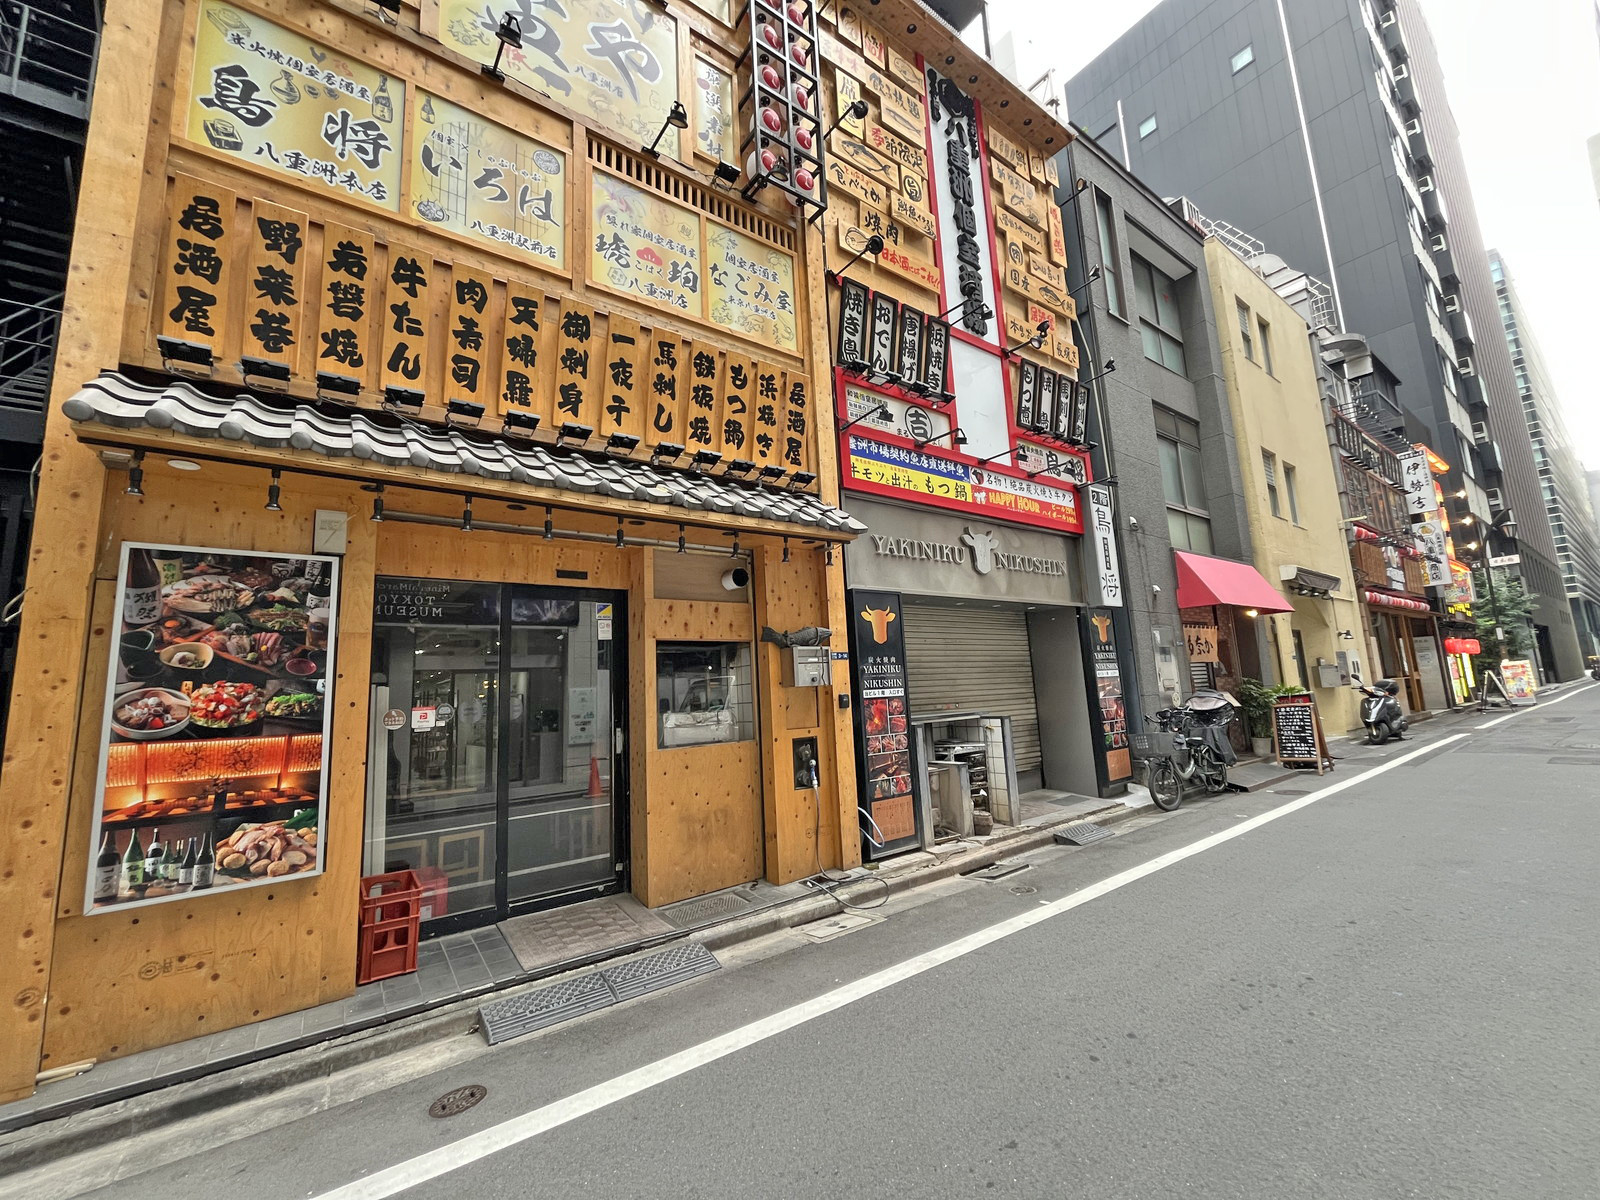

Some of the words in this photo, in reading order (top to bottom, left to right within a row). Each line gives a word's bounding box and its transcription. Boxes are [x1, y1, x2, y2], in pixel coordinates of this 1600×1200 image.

[254, 142, 389, 201] 八重洲本店
[421, 144, 561, 228] いろは
[169, 196, 224, 337] 居酒屋
[470, 220, 557, 259] 八重洲駅前店
[725, 251, 781, 285] 個室居酒屋
[250, 217, 302, 353] 野菜巻
[387, 256, 427, 380] 牛たん
[628, 277, 689, 310] 八重洲店
[709, 262, 794, 315] なごみ屋
[502, 296, 539, 407] 天婦羅
[558, 311, 591, 418] 御刺身
[606, 333, 635, 426] 一夜干
[872, 302, 891, 374] おでん
[653, 341, 677, 433] 馬刺し
[724, 364, 748, 450] もつ鍋
[756, 374, 778, 457] 浜焼き
[784, 382, 806, 467] 居酒屋
[989, 491, 1015, 508] HAPPY
[1017, 496, 1040, 514] HOUR
[871, 534, 965, 564] YAKINIKU
[994, 552, 1066, 576] NIKUSHIN
[863, 665, 901, 674] YAKINIKU
[864, 679, 902, 689] NIKUSHIN
